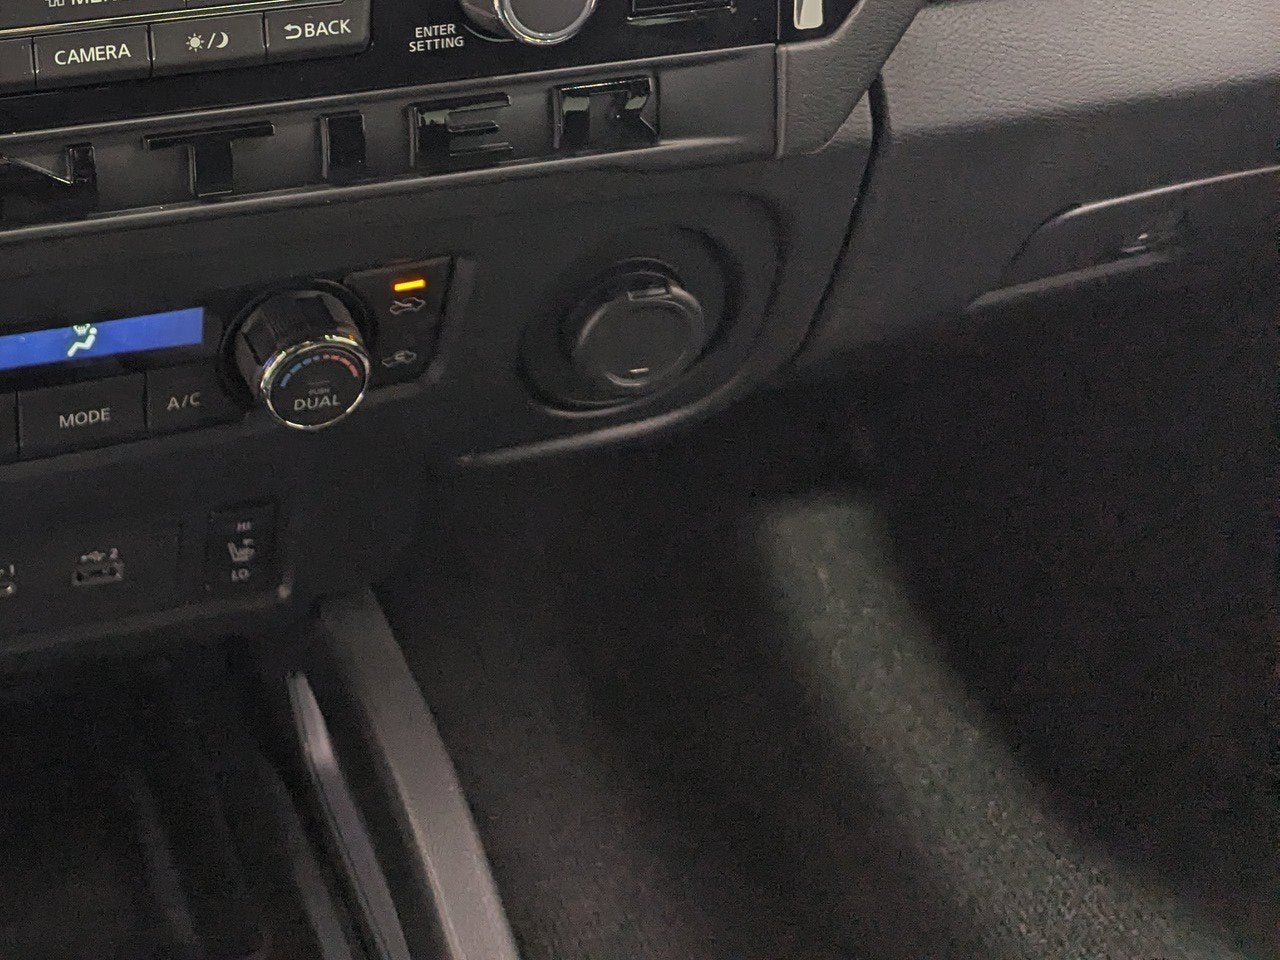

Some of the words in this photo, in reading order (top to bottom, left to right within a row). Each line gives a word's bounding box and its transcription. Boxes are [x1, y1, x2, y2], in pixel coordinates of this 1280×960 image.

[305, 19, 351, 37] BACK
[415, 24, 456, 38] ENTER
[409, 36, 464, 53] SETTING
[54, 43, 131, 66] CAMERA
[166, 392, 201, 411] A/C
[294, 394, 340, 412] DUAL
[59, 407, 111, 429] MODE
